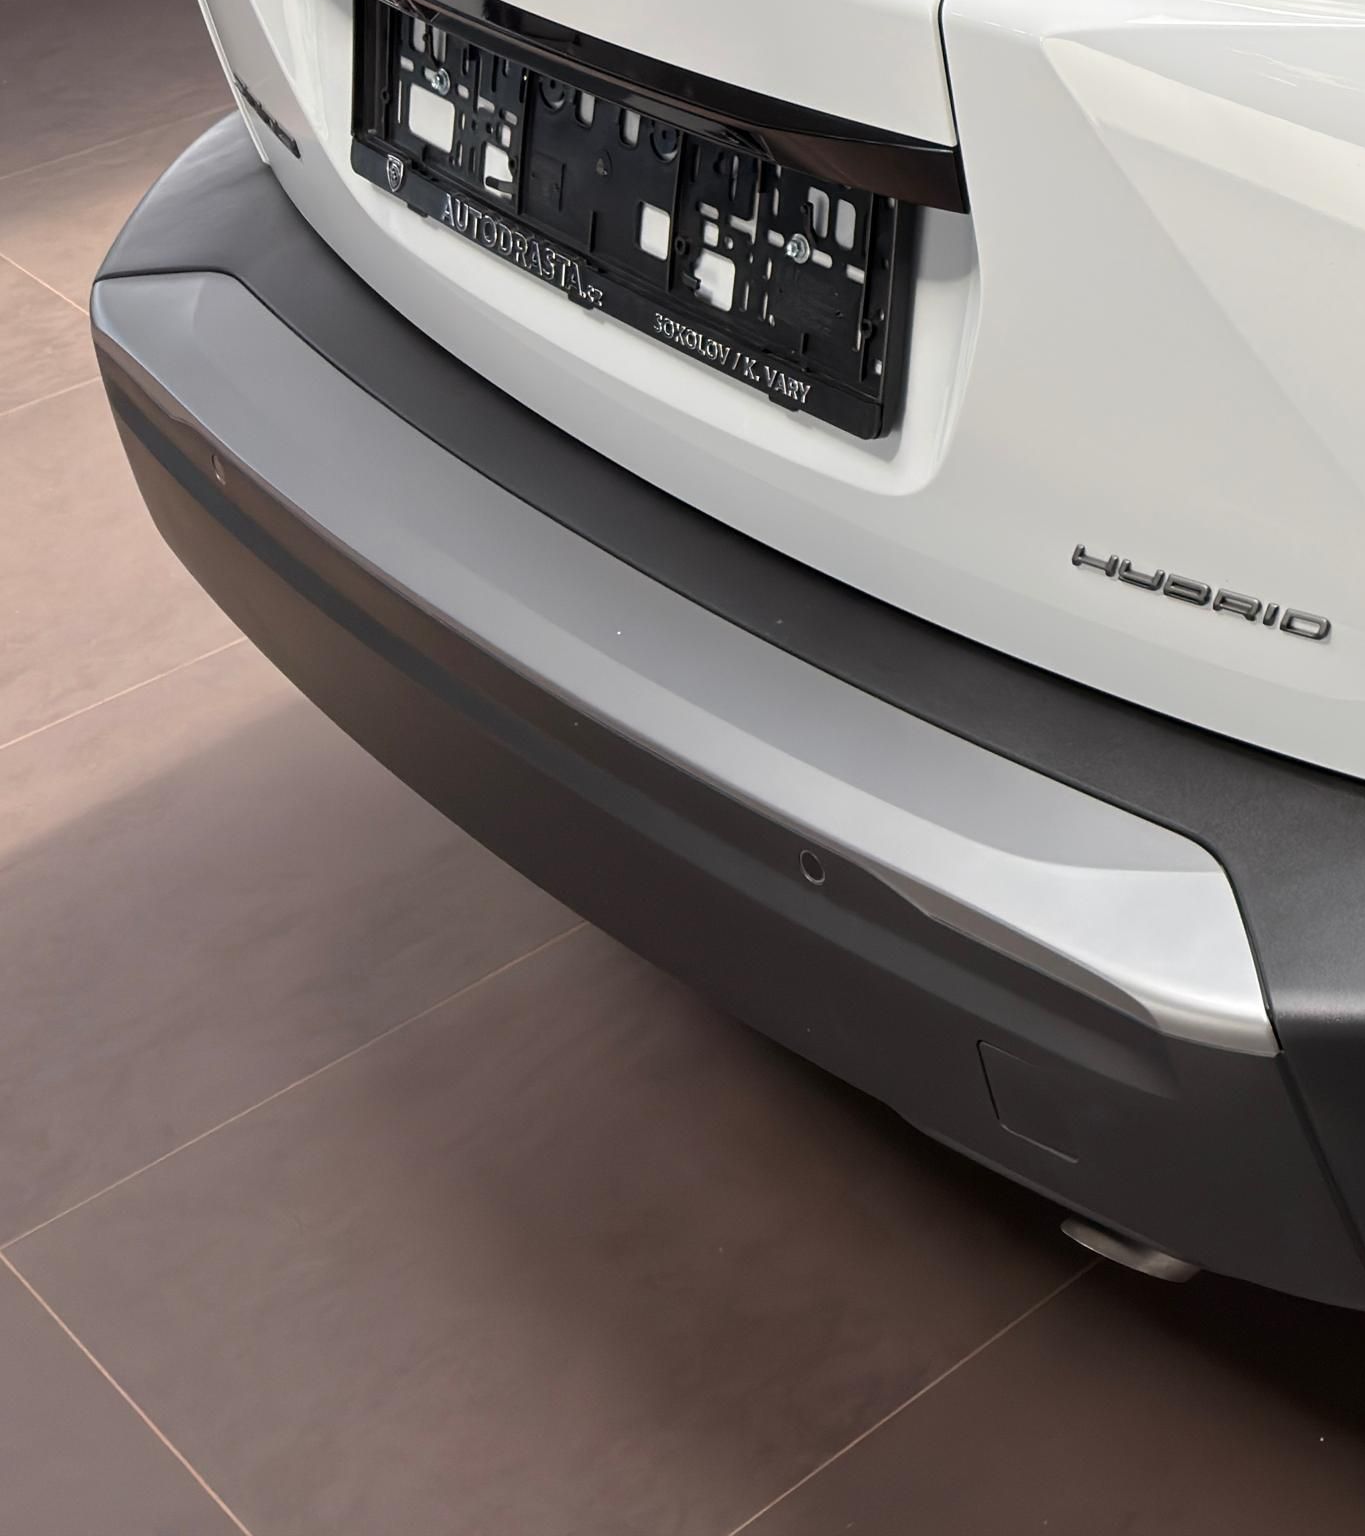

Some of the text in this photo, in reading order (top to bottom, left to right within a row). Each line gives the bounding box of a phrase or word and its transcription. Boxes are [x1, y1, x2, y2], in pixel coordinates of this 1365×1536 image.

[653, 312, 731, 366] SOKOLOV
[743, 356, 761, 382] K.
[763, 365, 811, 404] VARY
[1071, 543, 1332, 640] HYBRID
